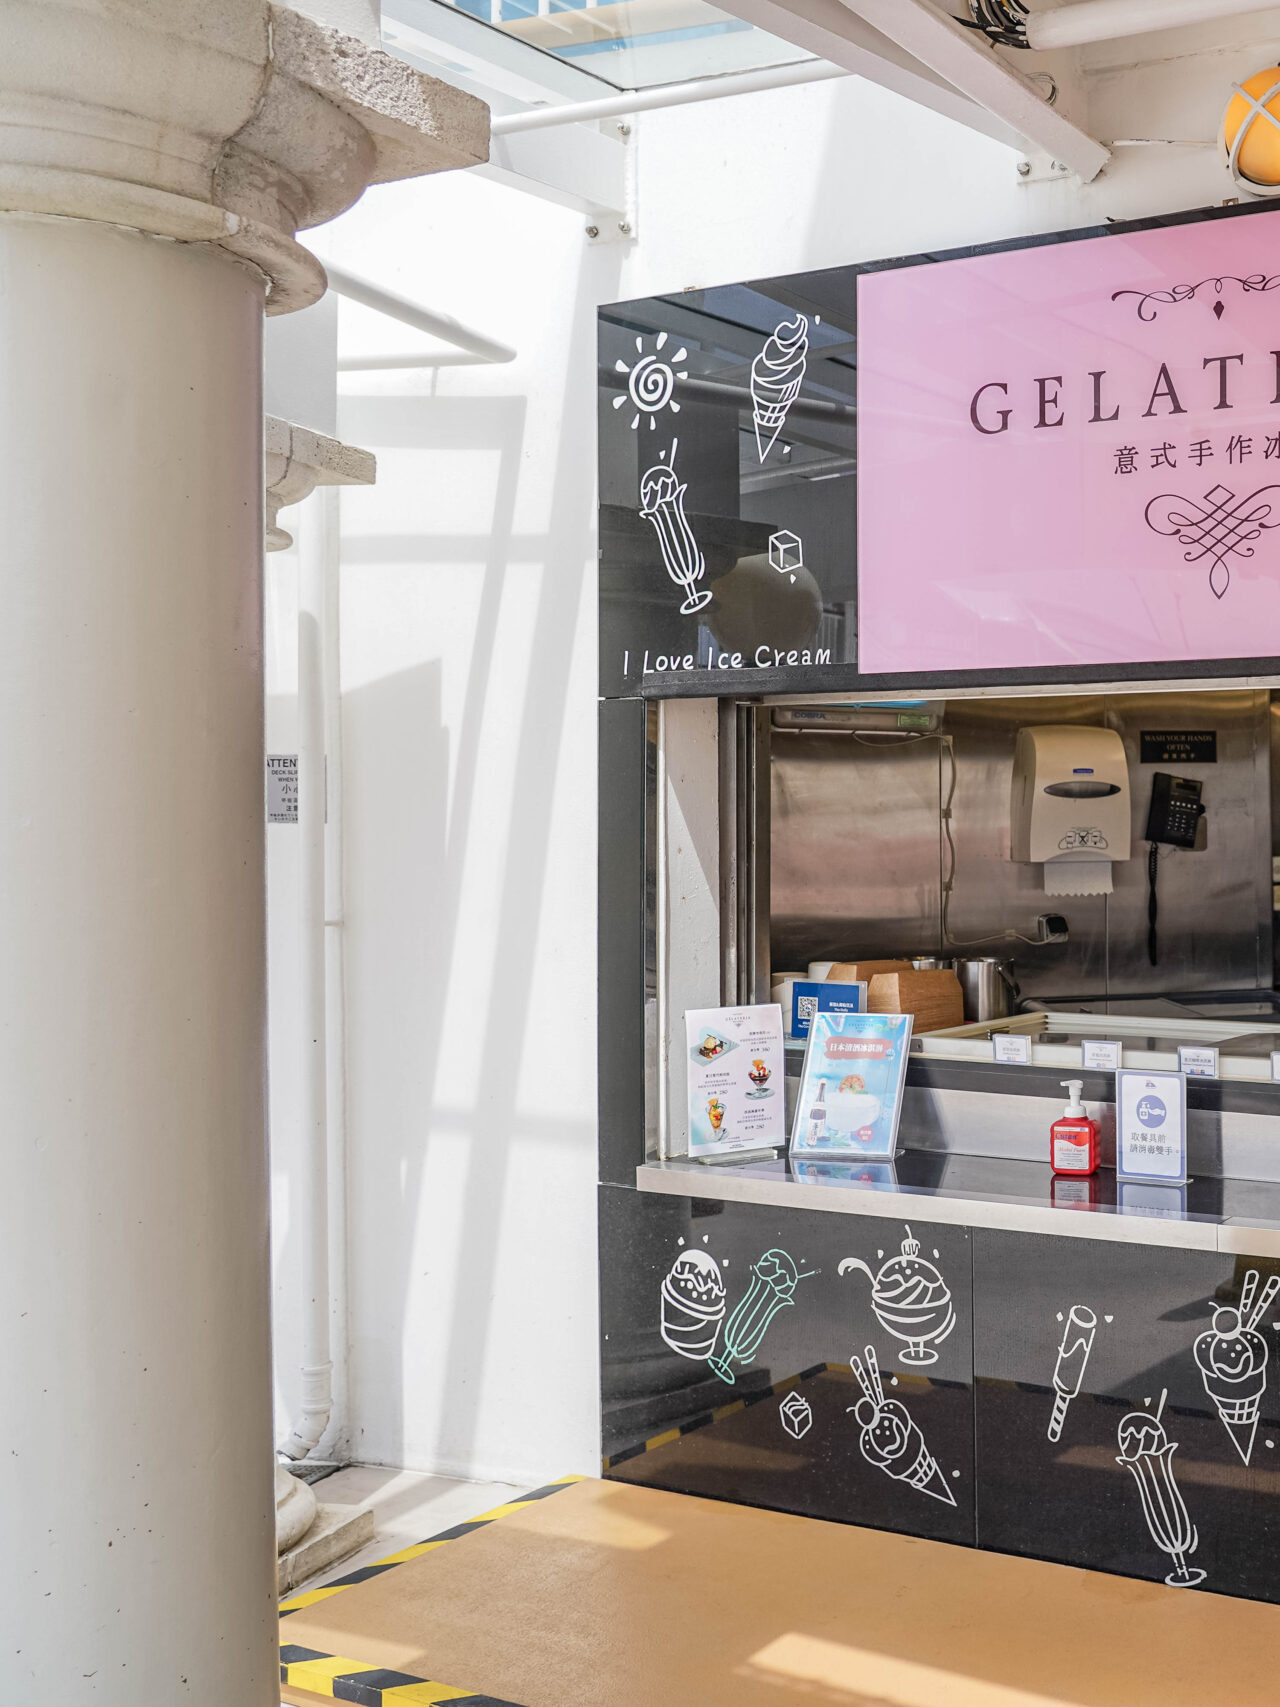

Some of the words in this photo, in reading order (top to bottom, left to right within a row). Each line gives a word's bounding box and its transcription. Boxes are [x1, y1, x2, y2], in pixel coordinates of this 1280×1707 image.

[623, 650, 629, 676] I
[643, 650, 694, 674] Love
[707, 647, 743, 671] Ice
[755, 645, 832, 668] Cream
[793, 711, 826, 719] COBRA
[1166, 743, 1190, 751] OFTEN
[267, 758, 298, 768] TTEN
[1131, 1132, 1167, 1144] 取餐具前
